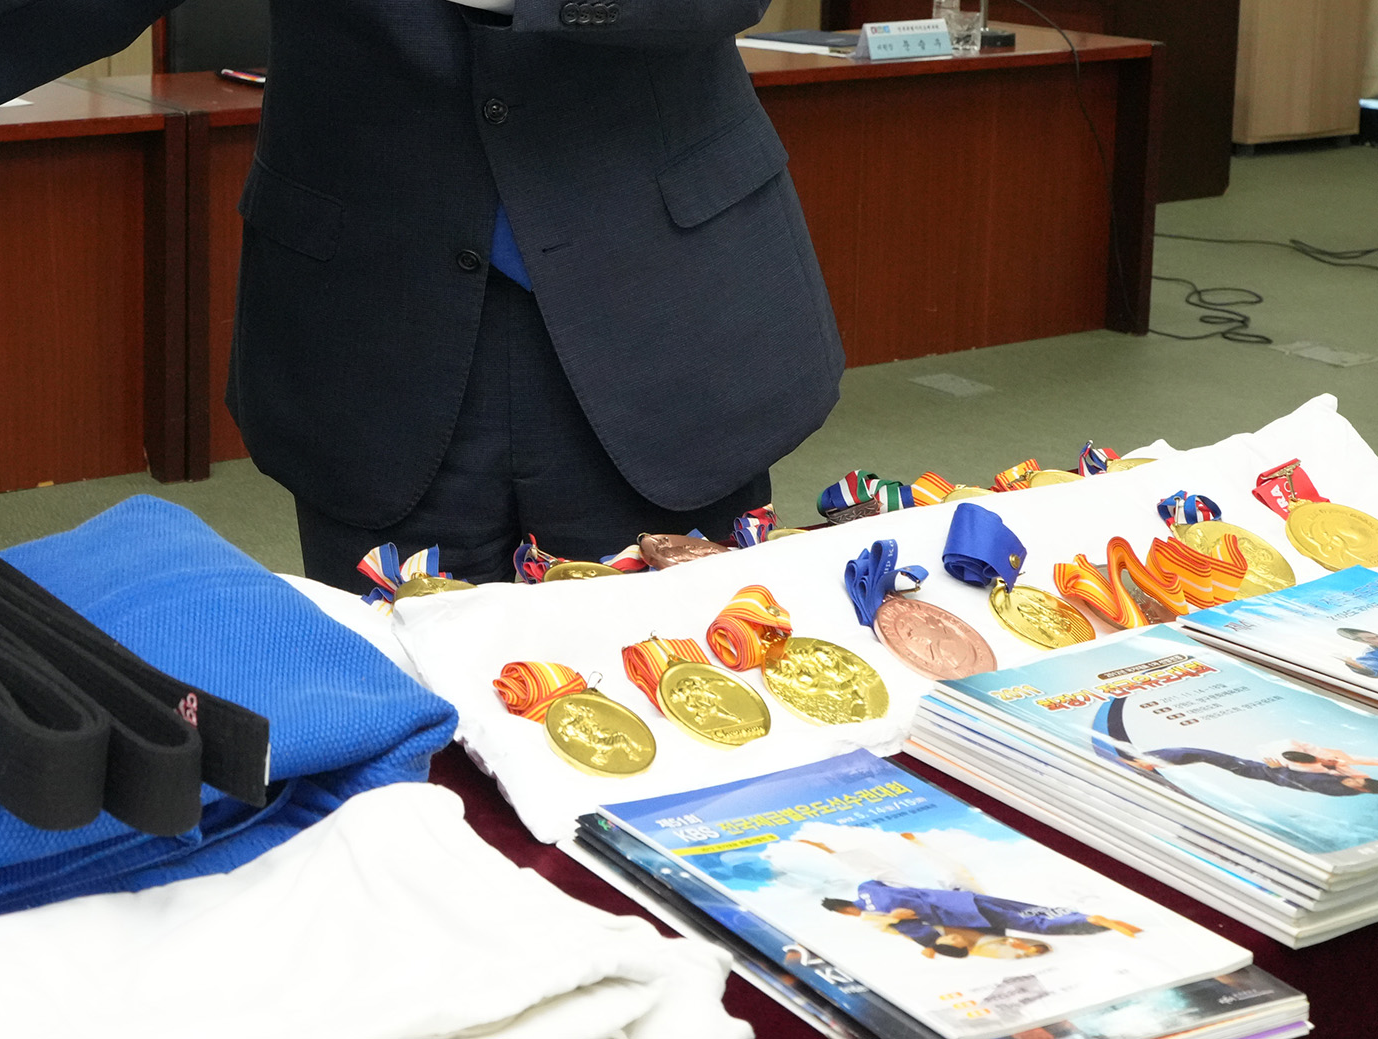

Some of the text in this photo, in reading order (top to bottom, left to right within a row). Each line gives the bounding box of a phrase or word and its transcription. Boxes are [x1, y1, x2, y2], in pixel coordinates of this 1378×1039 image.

[990, 685, 1042, 701] 2011
[1036, 660, 1218, 711] 회장기 전국유도대회
[655, 813, 704, 828] 제51회
[673, 824, 721, 843] KBS
[716, 780, 914, 836] 전국체급별유도선수권대회
